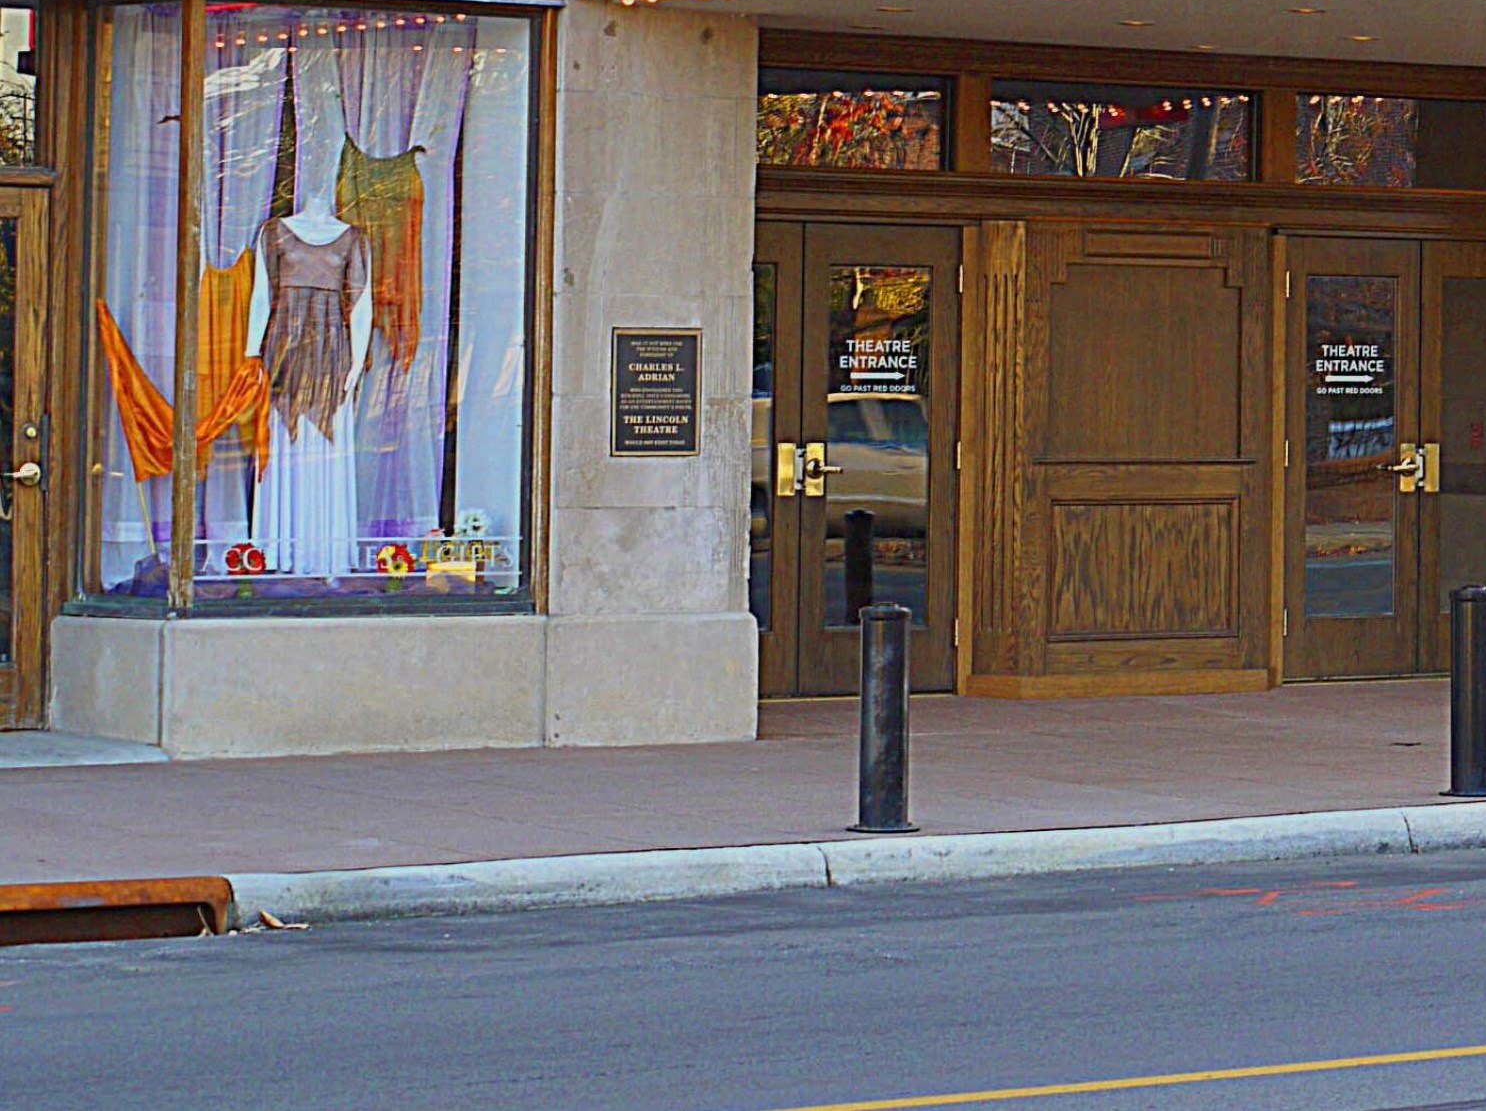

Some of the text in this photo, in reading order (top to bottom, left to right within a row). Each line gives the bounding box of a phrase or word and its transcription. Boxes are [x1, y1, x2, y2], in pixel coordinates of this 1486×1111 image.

[846, 339, 911, 353] THEATRE
[1321, 344, 1379, 357] THEATRE
[840, 355, 918, 369] ENTRANCE
[1315, 359, 1385, 372] ENTRANCE
[628, 363, 674, 372] CHARLES
[637, 373, 676, 382] ADRIAN
[840, 384, 916, 392] GO PAST RED DOORS
[624, 415, 689, 424] THE LINCOLN
[633, 425, 679, 434] THEATRE
